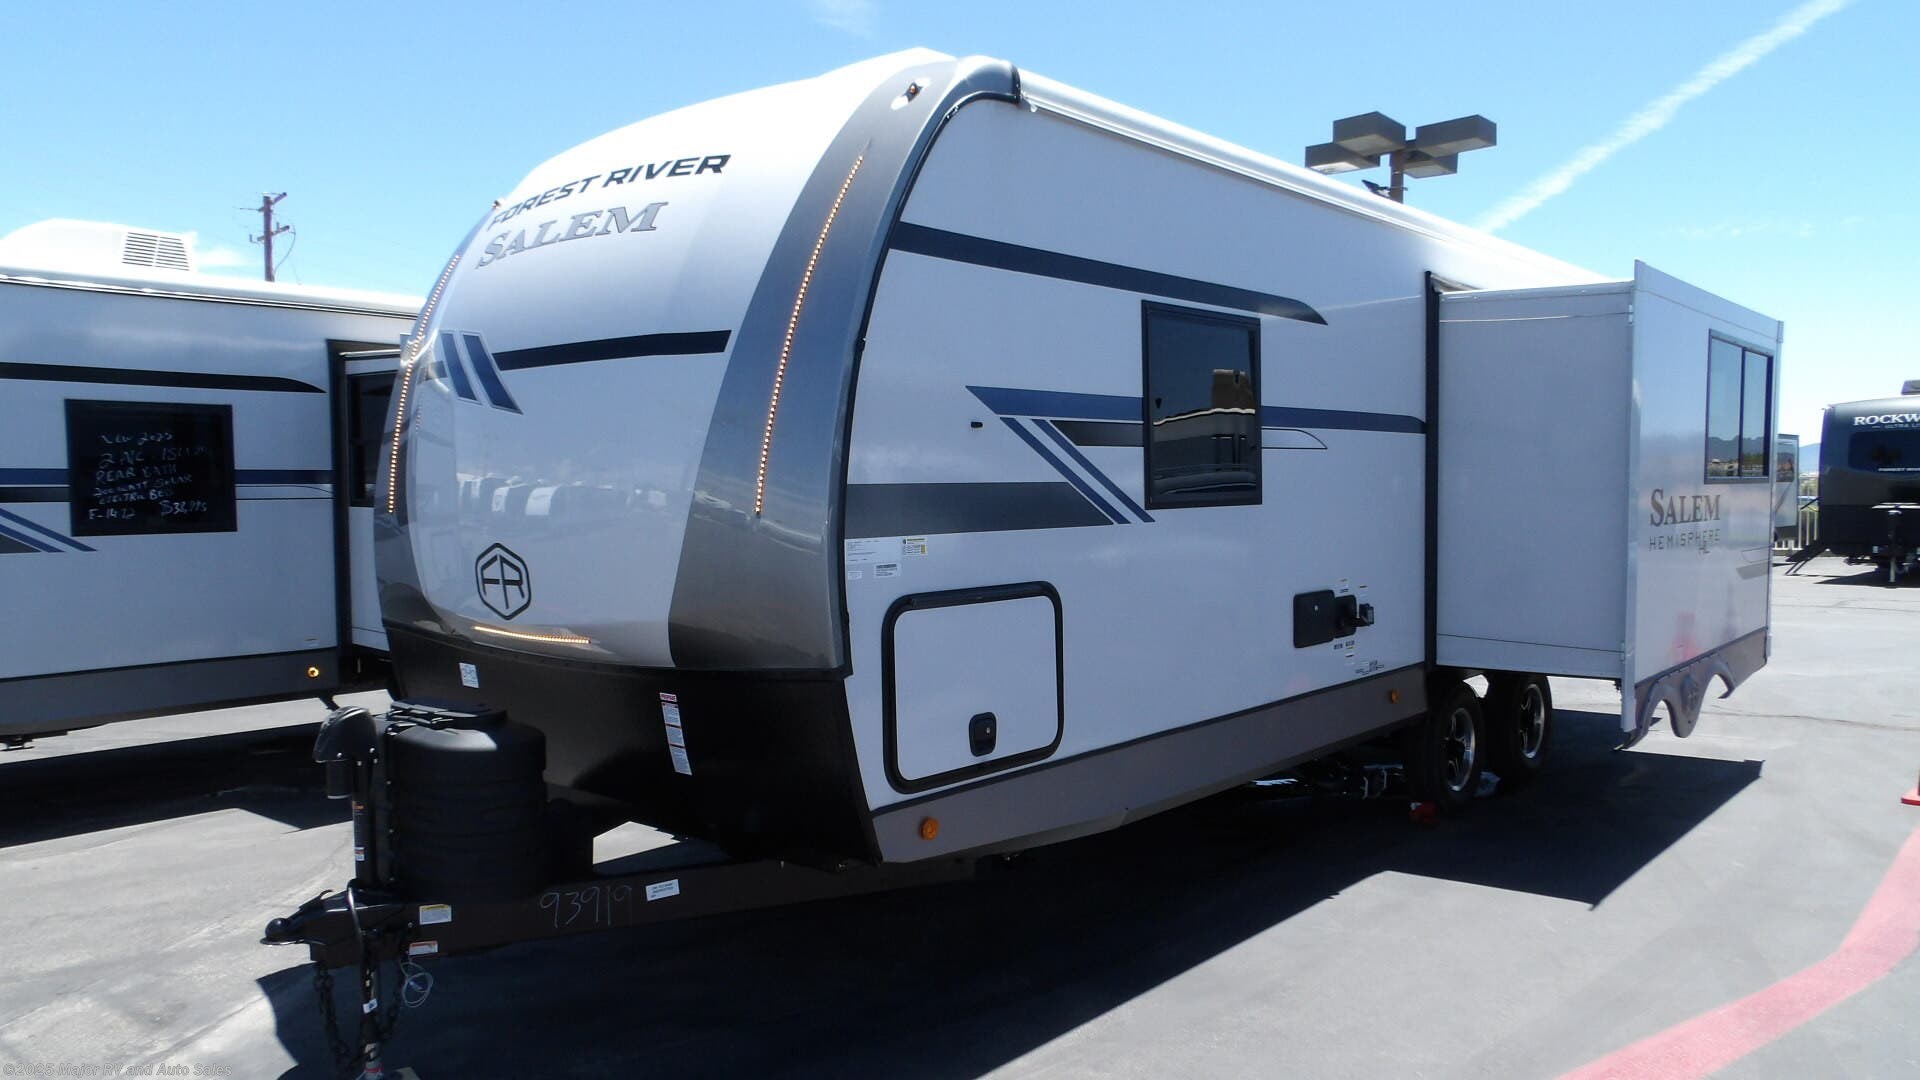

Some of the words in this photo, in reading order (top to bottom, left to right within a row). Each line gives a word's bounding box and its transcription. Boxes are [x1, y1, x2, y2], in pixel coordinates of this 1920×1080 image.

[486, 174, 601, 232] FOREST
[602, 154, 732, 188] RIVER
[474, 201, 669, 270] SALEM
[95, 466, 137, 485] REAR
[1650, 489, 1721, 527] SALEM
[1649, 528, 1721, 552] HEMISPHERE
